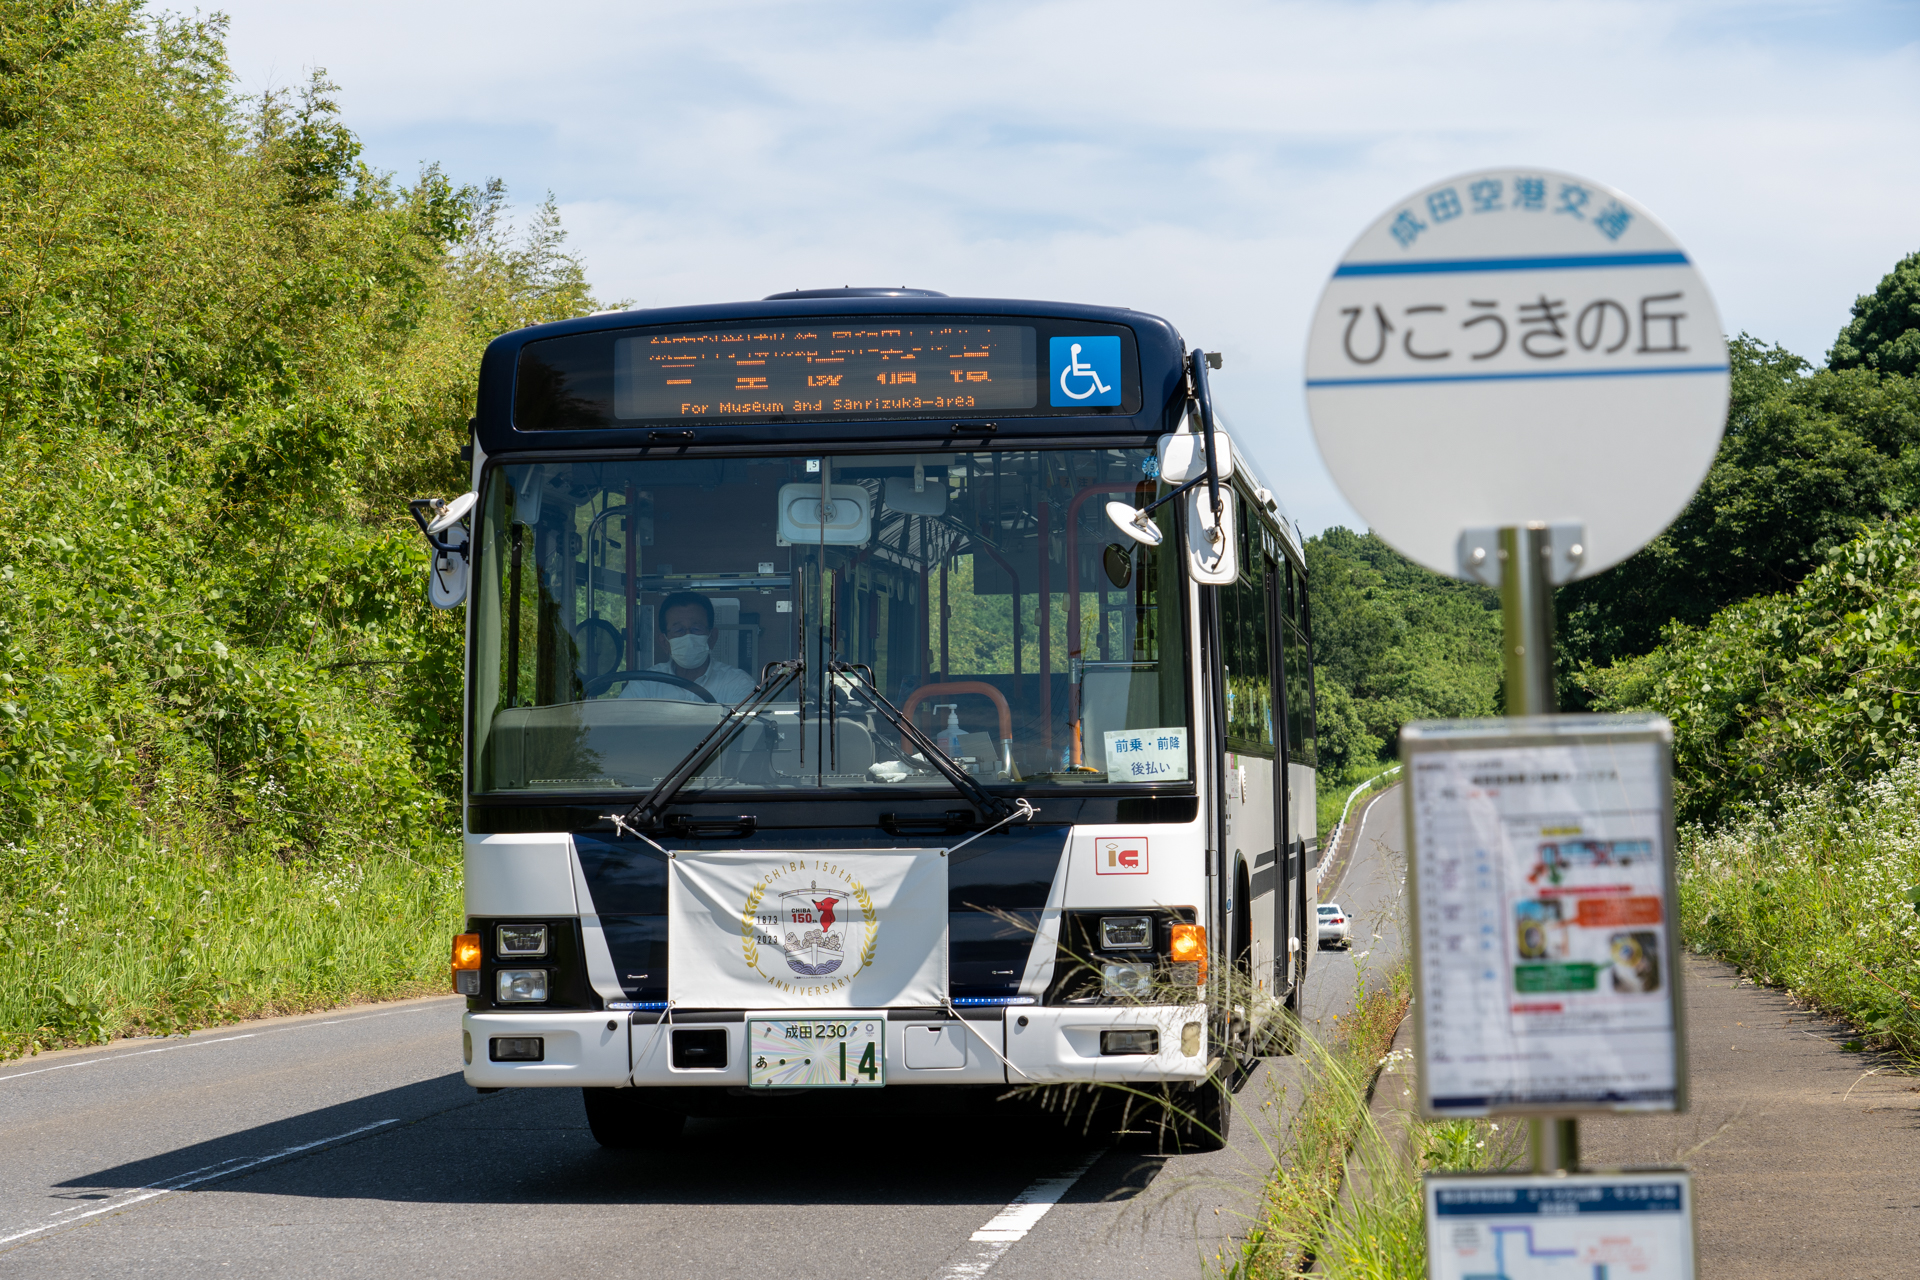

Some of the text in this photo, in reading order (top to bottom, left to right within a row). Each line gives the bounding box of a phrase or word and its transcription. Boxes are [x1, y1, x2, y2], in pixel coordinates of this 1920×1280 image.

[1388, 176, 1634, 249] 成田空港交通
[1340, 292, 1691, 365] ひこうきの丘
[681, 403, 709, 415] For
[719, 401, 784, 414] Museum
[792, 399, 822, 412] and
[1115, 736, 1180, 753] 前乗・前降
[1131, 761, 1171, 776] 後払い
[764, 860, 852, 884] CHIBA 150th
[757, 915, 778, 925] 1873
[757, 935, 778, 944] 2023
[768, 975, 852, 997] ANNIVERSARY
[755, 1055, 768, 1069] あ
